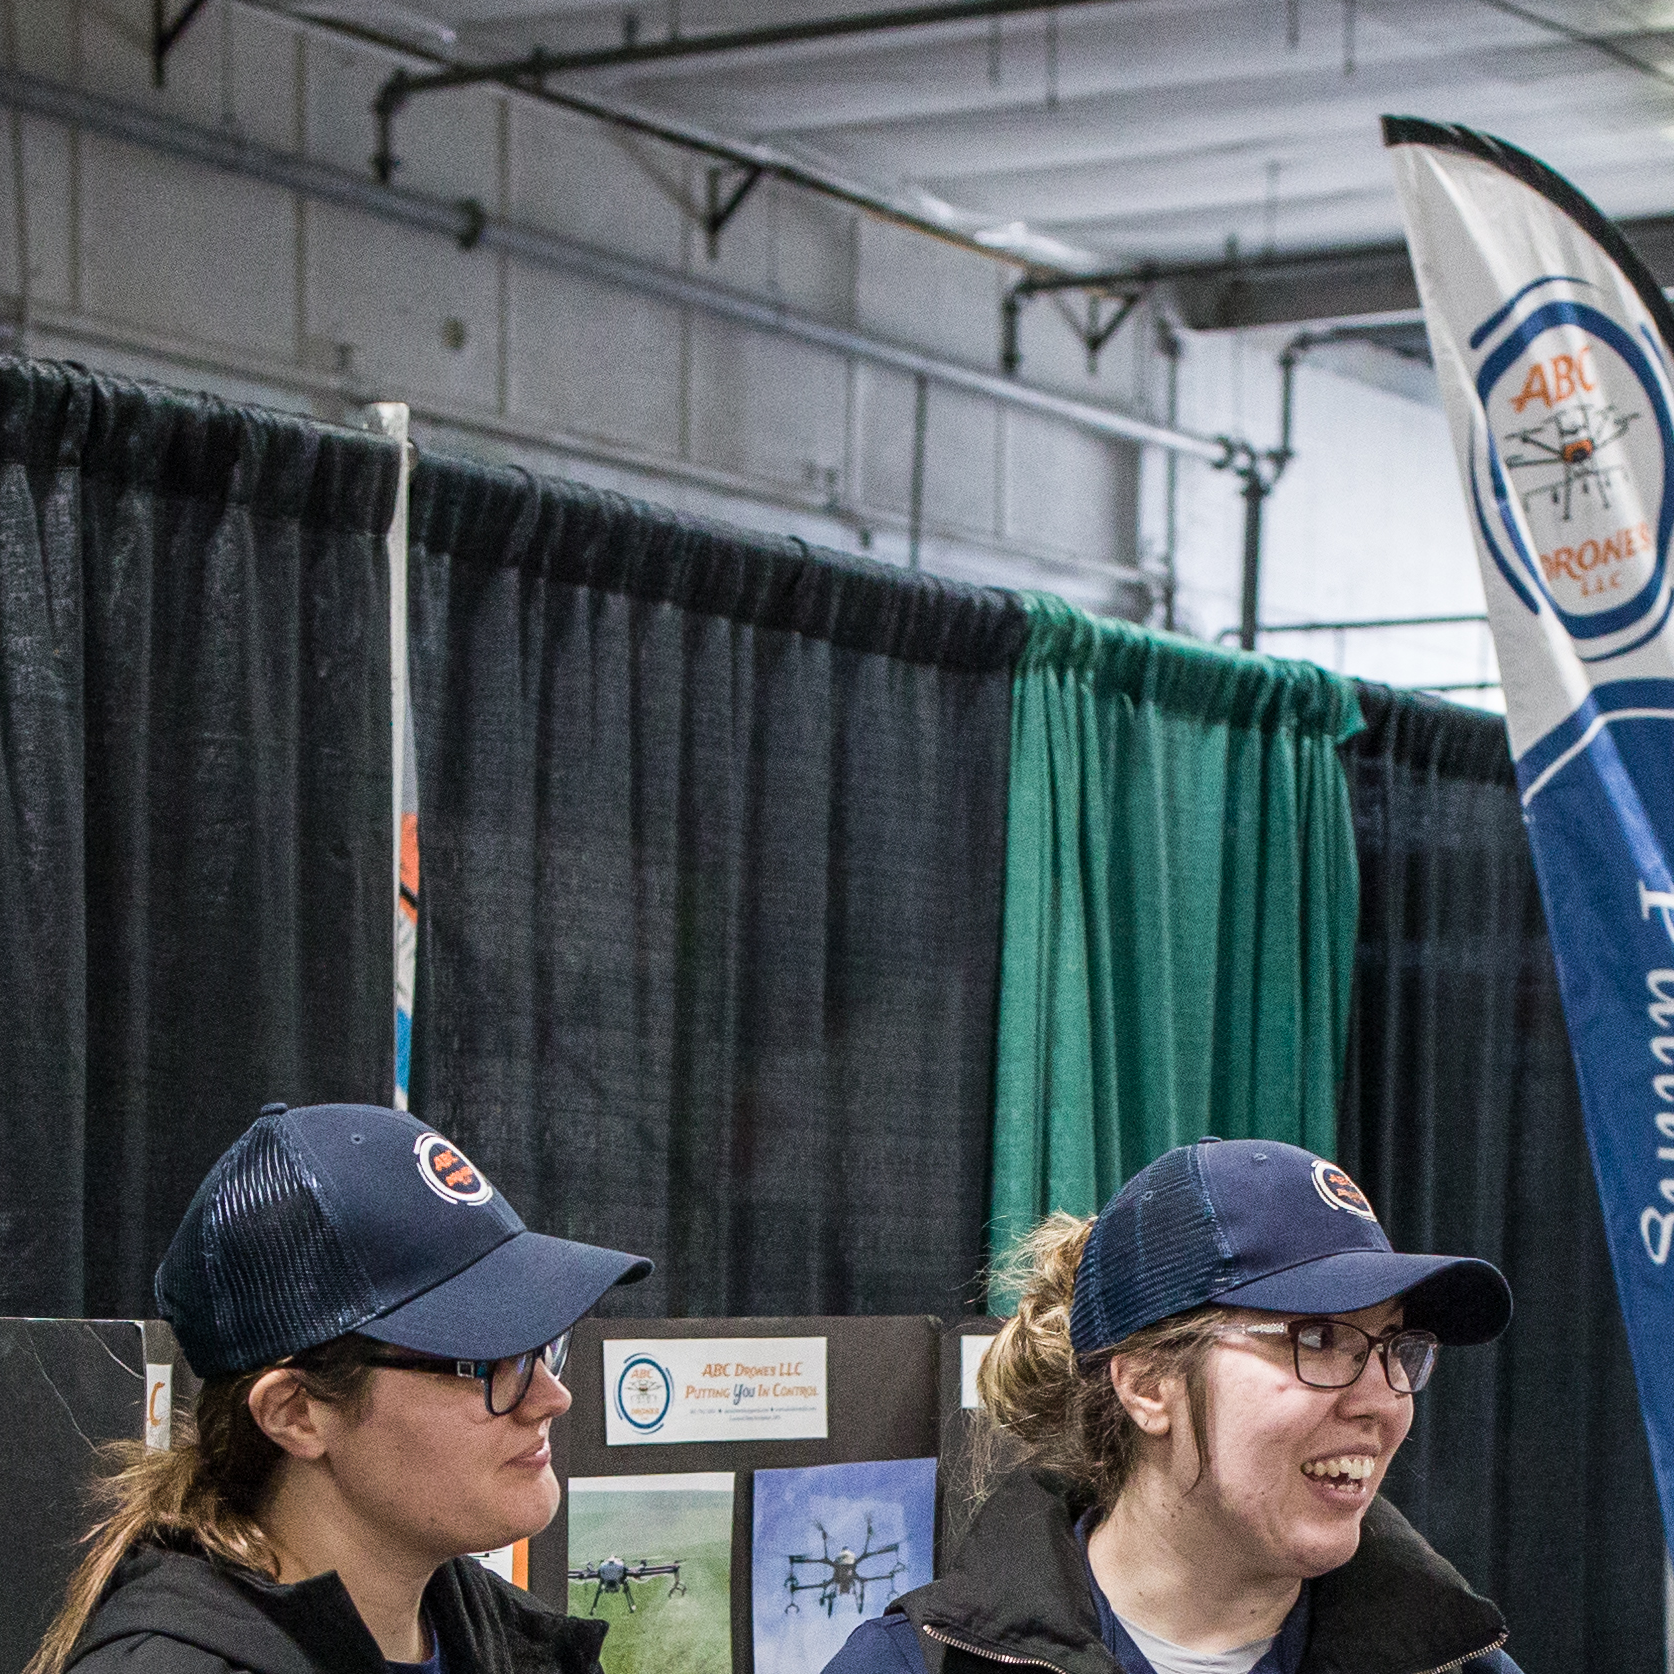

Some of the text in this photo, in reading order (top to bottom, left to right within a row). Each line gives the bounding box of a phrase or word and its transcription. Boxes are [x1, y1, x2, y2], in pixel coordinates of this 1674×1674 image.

[1510, 346, 1597, 414] ABC
[702, 1362, 731, 1378] ABC
[779, 1361, 803, 1377] LLC
